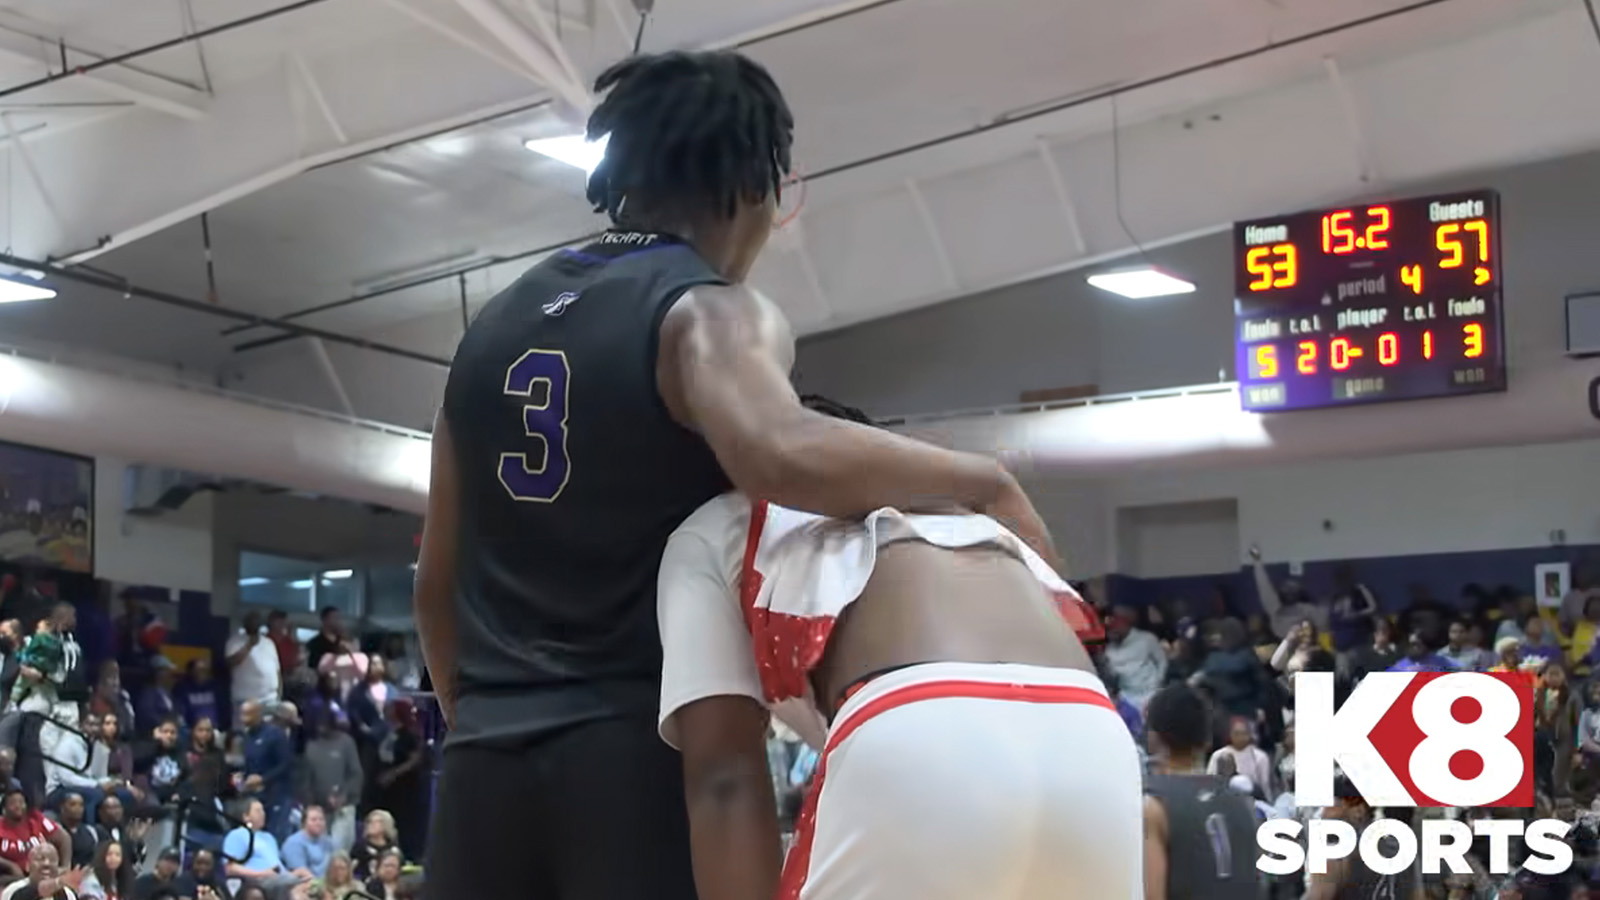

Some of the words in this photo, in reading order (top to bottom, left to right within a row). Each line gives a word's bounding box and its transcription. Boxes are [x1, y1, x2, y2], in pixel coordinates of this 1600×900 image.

[1245, 225, 1288, 246] Home
[1322, 206, 1390, 254] 15.2
[1436, 219, 1488, 269] 57
[1246, 243, 1297, 291] 53
[1338, 275, 1387, 301] period
[1401, 264, 1422, 294] 4
[1337, 307, 1388, 331] player
[1256, 344, 1279, 378] 5
[1297, 341, 1318, 375] 2
[1422, 329, 1433, 361] 1
[1462, 322, 1484, 358] 3
[498, 348, 571, 503] 3
[1205, 812, 1232, 878] 1
